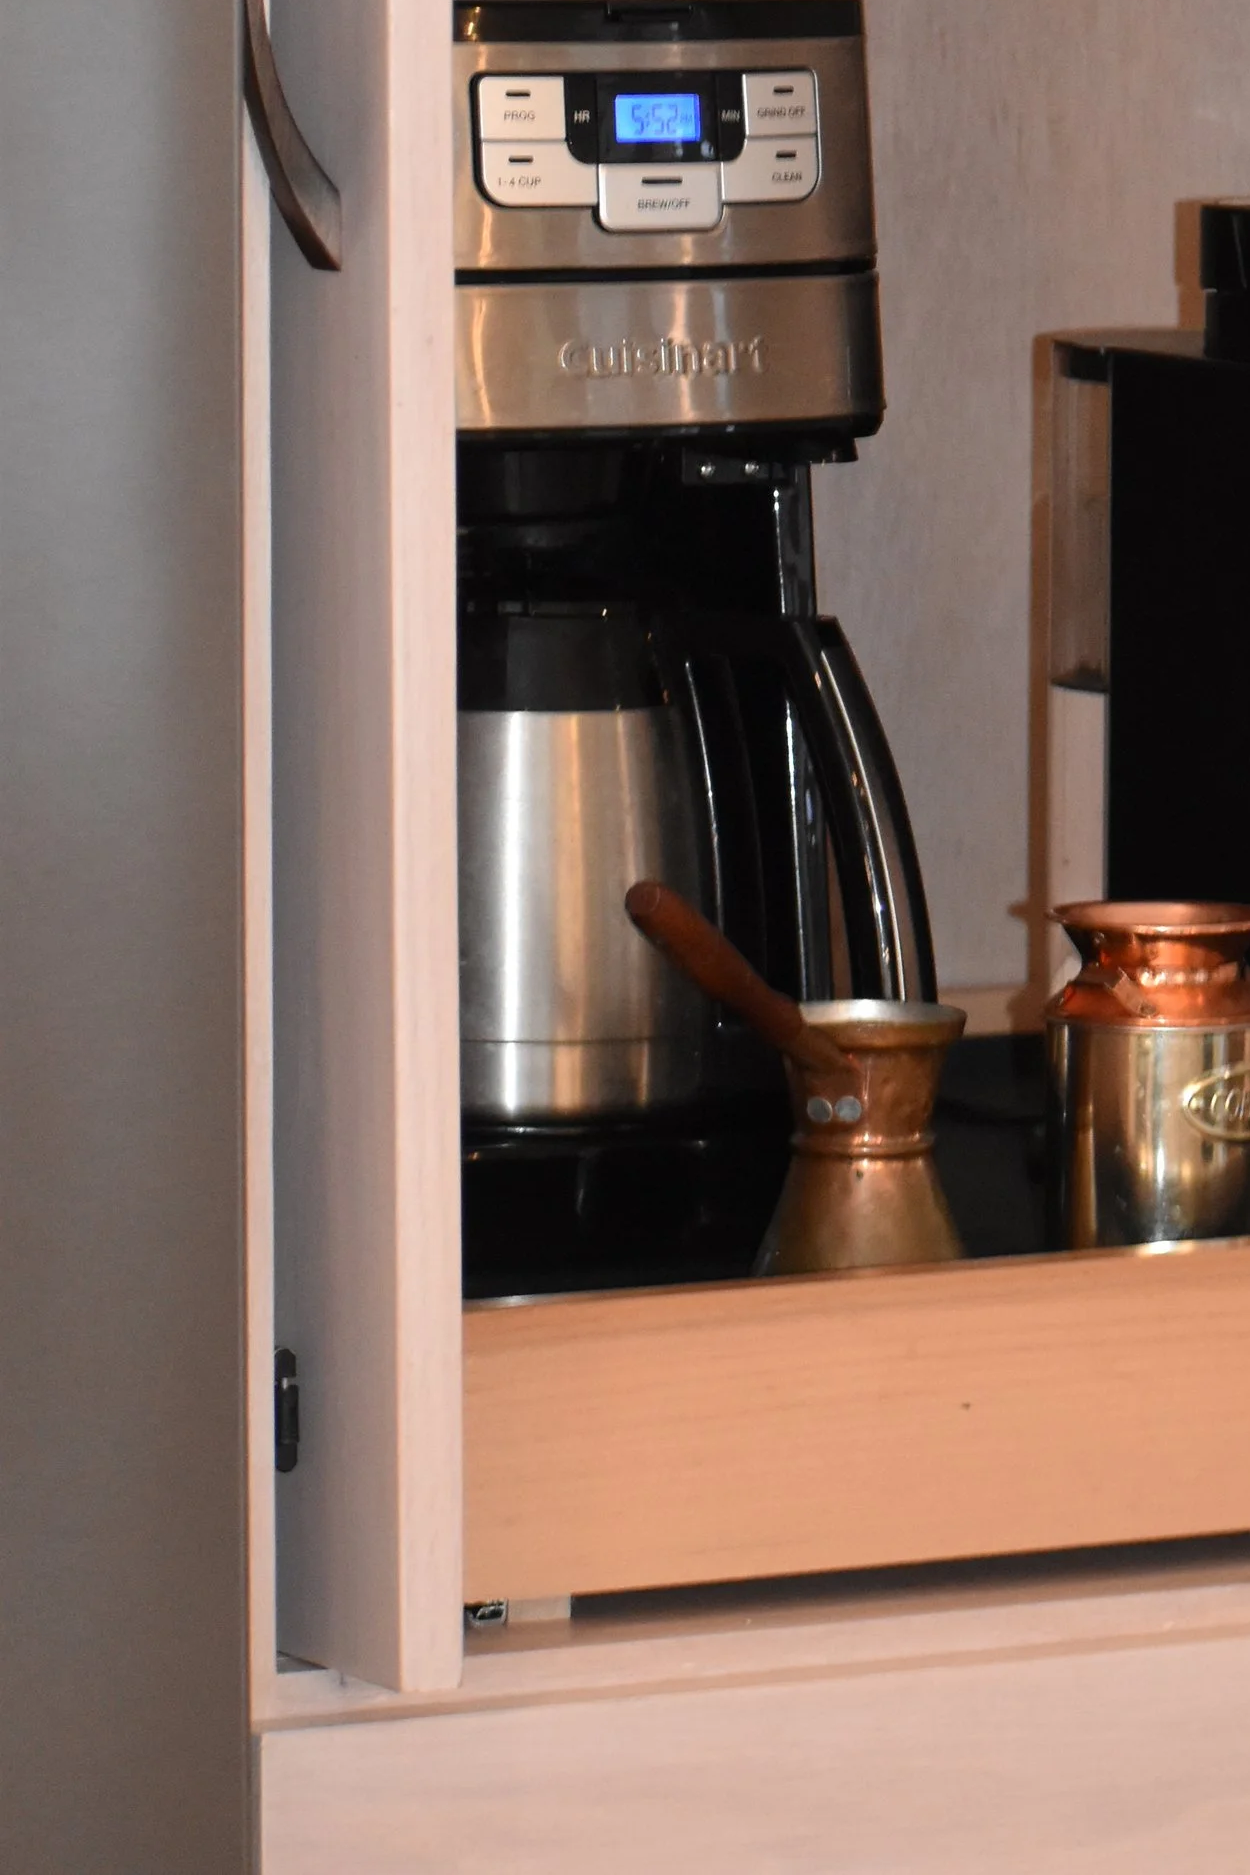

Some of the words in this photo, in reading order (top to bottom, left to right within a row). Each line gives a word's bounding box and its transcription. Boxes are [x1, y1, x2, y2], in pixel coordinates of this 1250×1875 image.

[573, 109, 591, 124] HR
[631, 102, 679, 136] 5:52
[721, 109, 741, 123] MIN
[772, 171, 803, 183] CLEAN
[557, 337, 763, 375] Cuisinart
